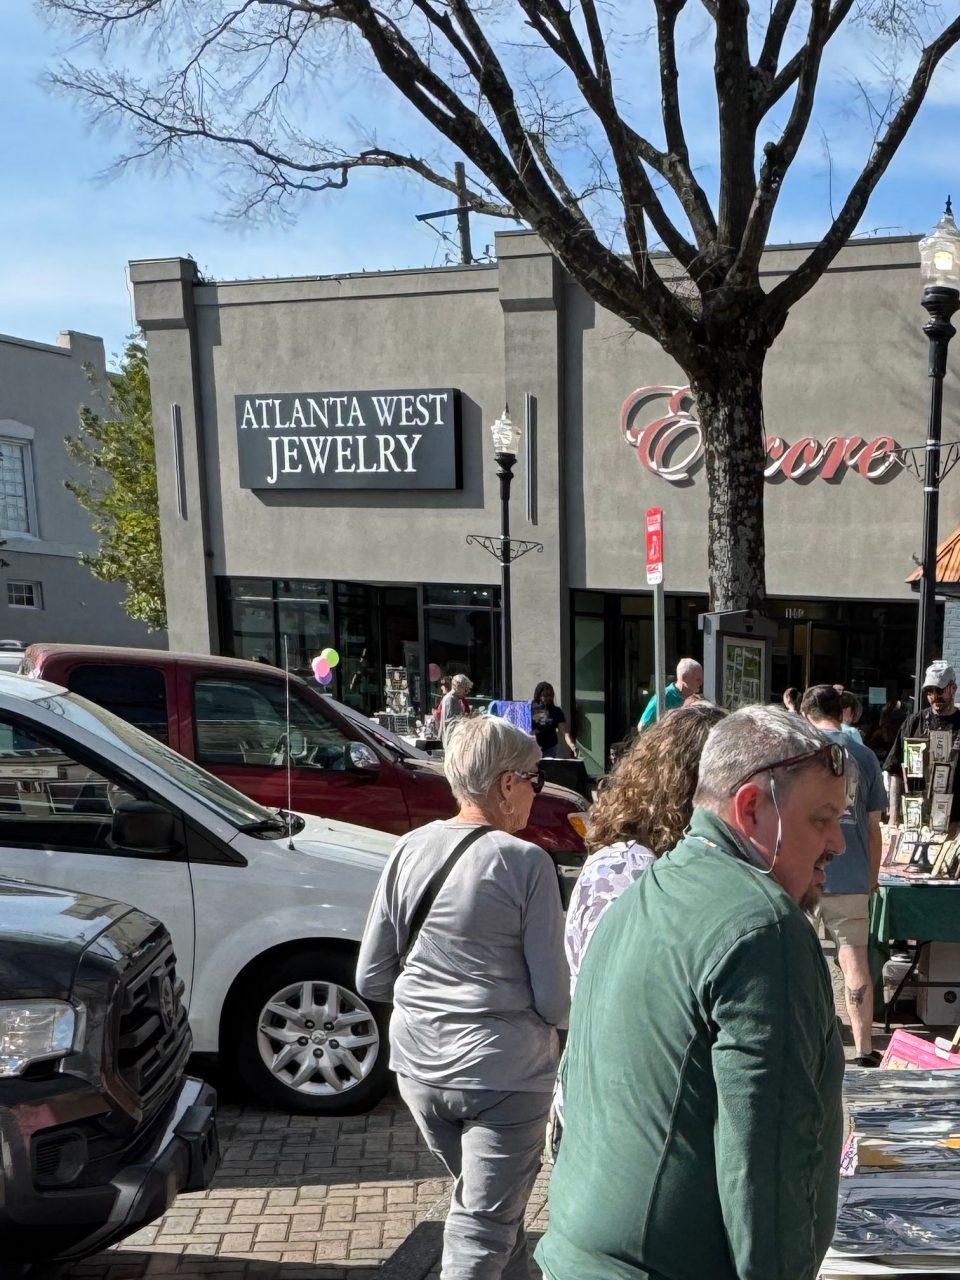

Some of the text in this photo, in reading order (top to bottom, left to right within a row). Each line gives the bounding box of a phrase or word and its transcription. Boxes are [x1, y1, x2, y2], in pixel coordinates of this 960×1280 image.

[240, 393, 448, 428] ATLANTA WEST
[266, 434, 423, 484] JEWELRY
